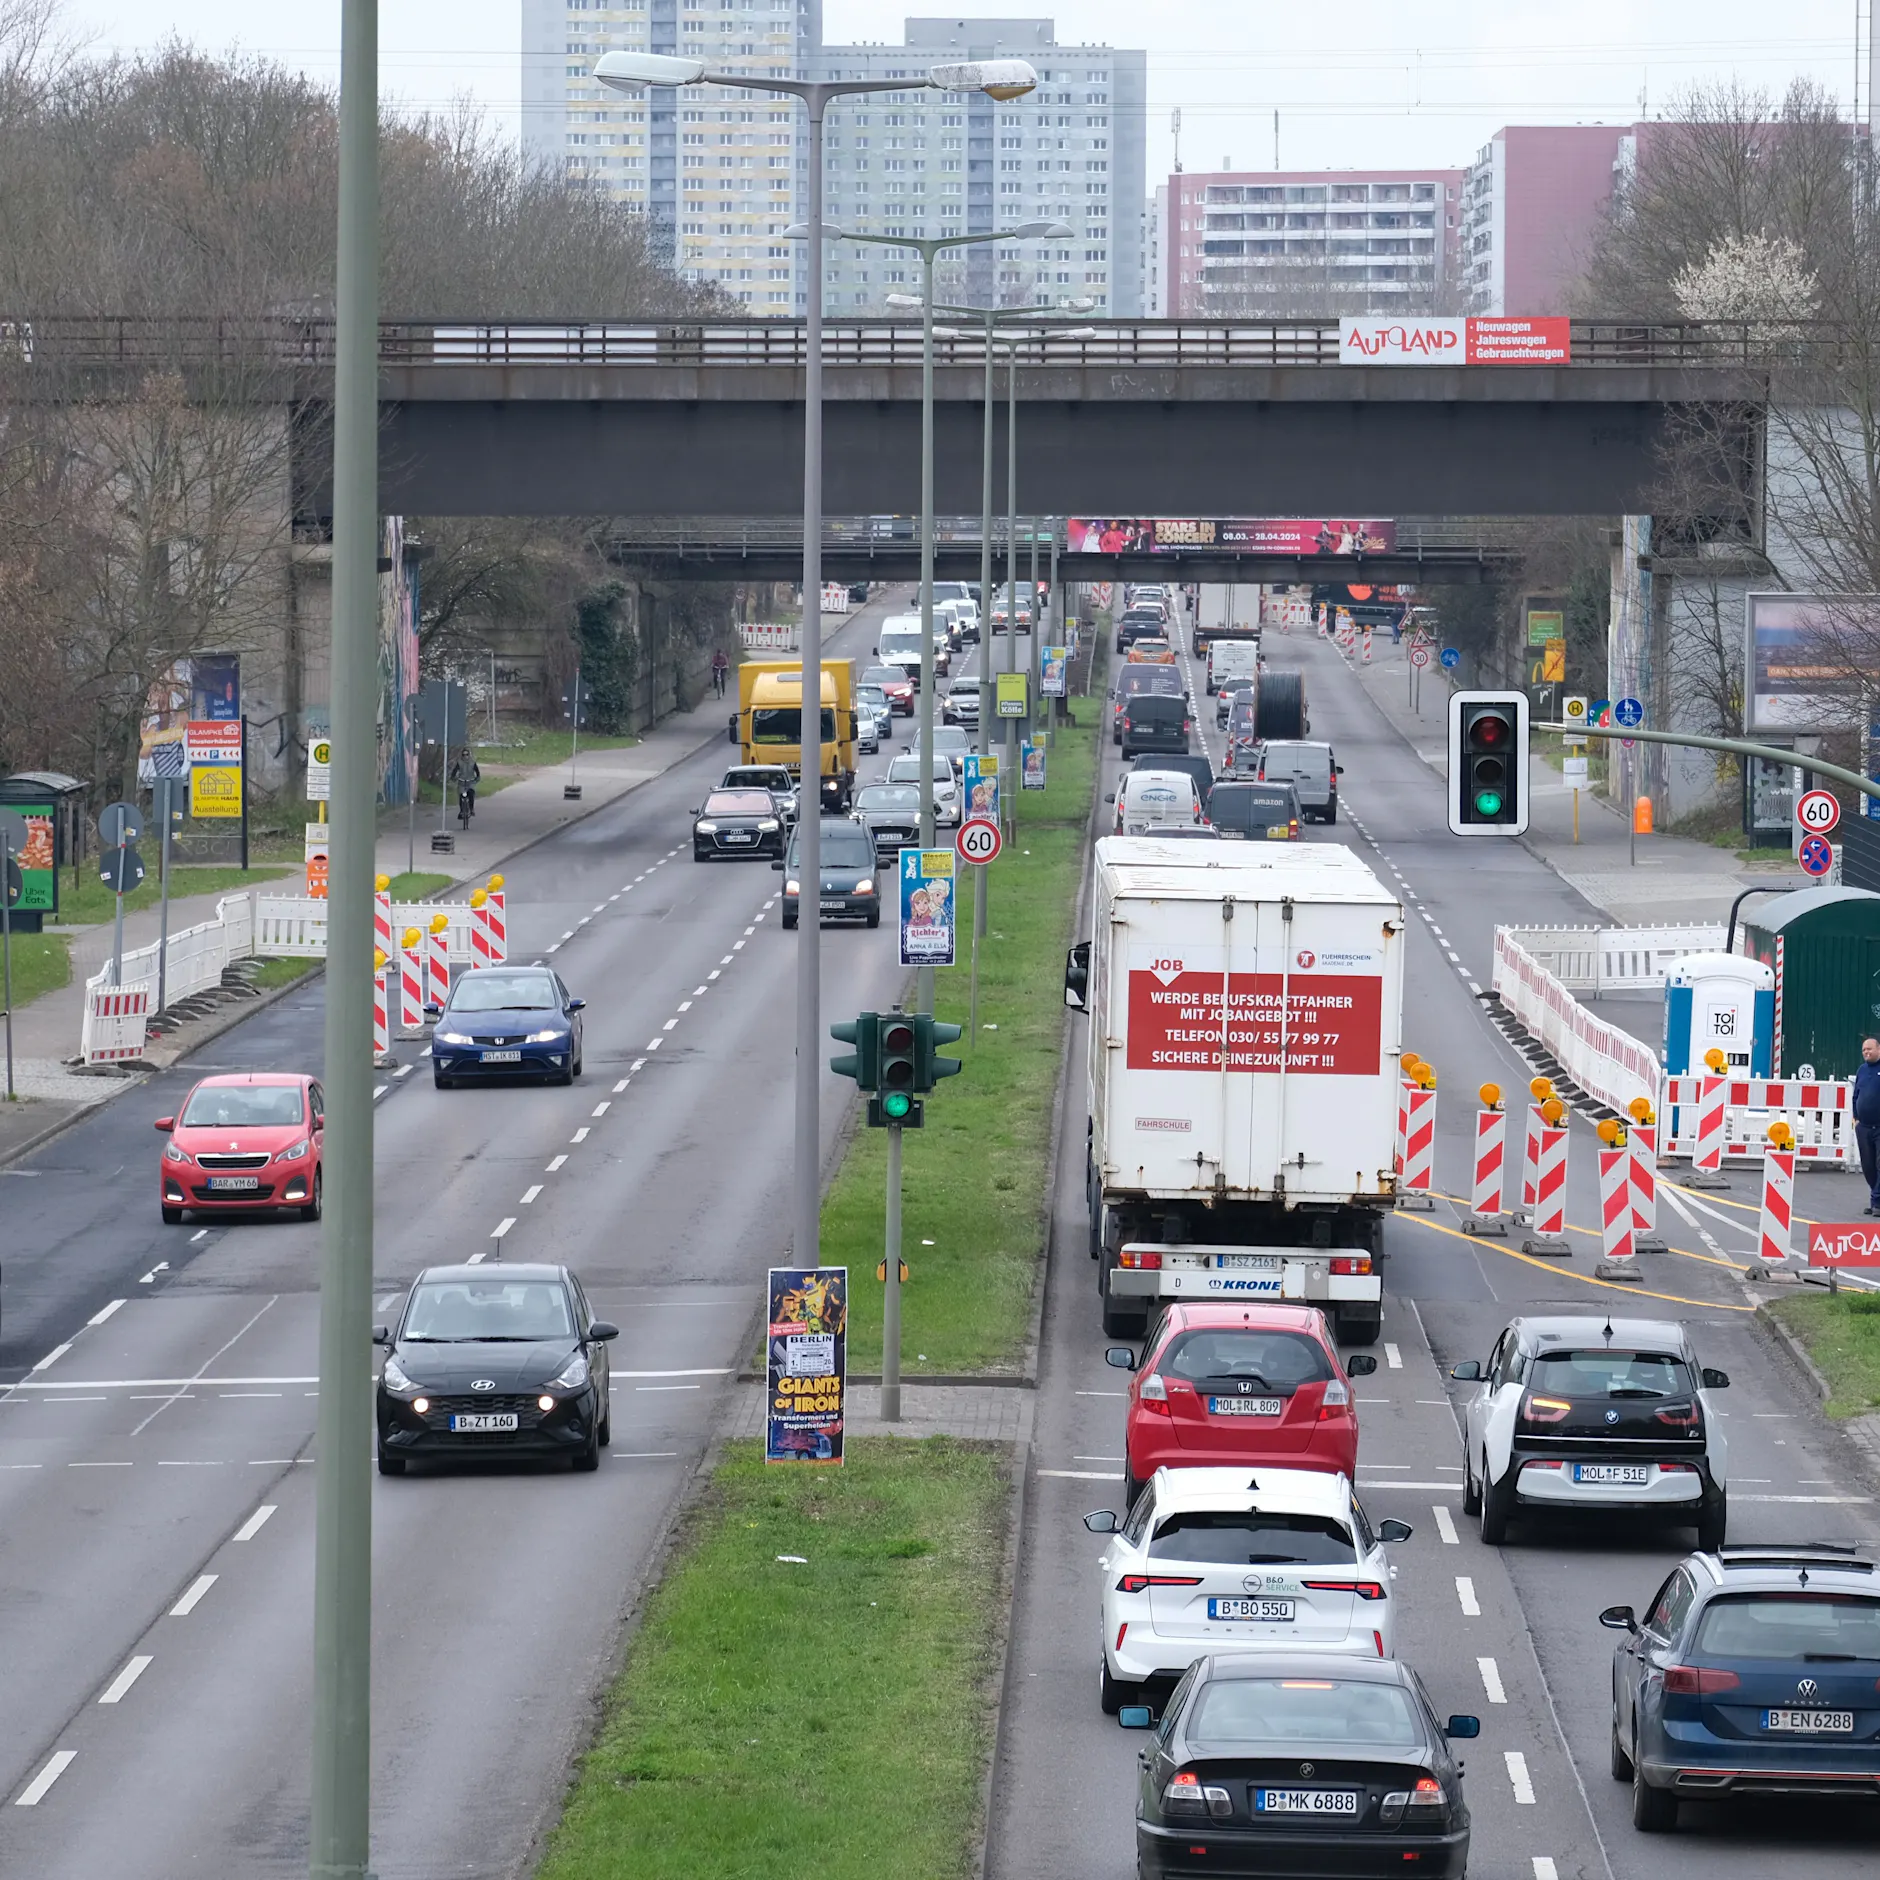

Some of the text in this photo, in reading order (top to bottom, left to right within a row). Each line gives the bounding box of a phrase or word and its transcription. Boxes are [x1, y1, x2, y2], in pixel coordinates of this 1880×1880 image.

[1476, 321, 1531, 333] Neuwagen
[1347, 325, 1457, 355] AUTOLAND
[1476, 334, 1546, 346] Jahreswagen
[1476, 347, 1564, 359] Gebrauchtwagen
[1155, 522, 1197, 533] STARS
[1199, 522, 1216, 533] IN
[1155, 532, 1216, 544] CONCERT
[1223, 533, 1249, 541] 08.03.
[1255, 533, 1301, 541] 28.04.2024
[1414, 654, 1424, 663] 30
[188, 729, 223, 737] GLAMPKE
[211, 750, 218, 758] P
[1253, 798, 1284, 807] amazon
[193, 805, 239, 815] Ausstellung
[1806, 802, 1830, 821] 60
[966, 831, 991, 851] 60
[25, 888, 46, 896] Uber
[25, 896, 46, 904] Eats
[1150, 959, 1184, 971] JOB
[1151, 992, 1199, 1005] WERDE
[1180, 1008, 1317, 1024] MIT JOBANGEBOT !!!
[1713, 1024, 1733, 1036] TOI
[1165, 1029, 1223, 1043] TELEFON
[1229, 1032, 1260, 1044] 030/
[1263, 1032, 1279, 1044] 55
[1302, 1033, 1320, 1045] 99
[1323, 1034, 1340, 1045] 77
[1152, 1051, 1209, 1064] SICHERE
[1321, 1055, 1335, 1067] !!!
[1801, 1067, 1812, 1079] 25
[1137, 1120, 1190, 1130] FAHRSCHULE
[212, 1179, 229, 1188] BAR
[246, 1179, 257, 1187] 66
[1224, 1256, 1275, 1268] B SZ 2161
[1174, 1277, 1181, 1288] D
[1223, 1280, 1283, 1291] KRONE
[790, 1335, 832, 1344] BERLIN
[778, 1376, 840, 1395] GIANTS
[774, 1395, 839, 1412] OF IRON
[1216, 1399, 1279, 1413] MOL RL 809
[460, 1415, 513, 1427] B ZT 160
[783, 1422, 831, 1430] Superhelden
[1582, 1467, 1646, 1480] MOL F 51E
[1266, 1584, 1300, 1592] SERVICE
[1222, 1602, 1231, 1615] B
[1262, 1602, 1288, 1616] 550
[1770, 1712, 1780, 1727] B
[1790, 1712, 1811, 1728] EN
[1813, 1713, 1851, 1729] 6288
[1267, 1792, 1277, 1809] B
[1288, 1793, 1310, 1809] MK
[1313, 1794, 1355, 1811] 6888
